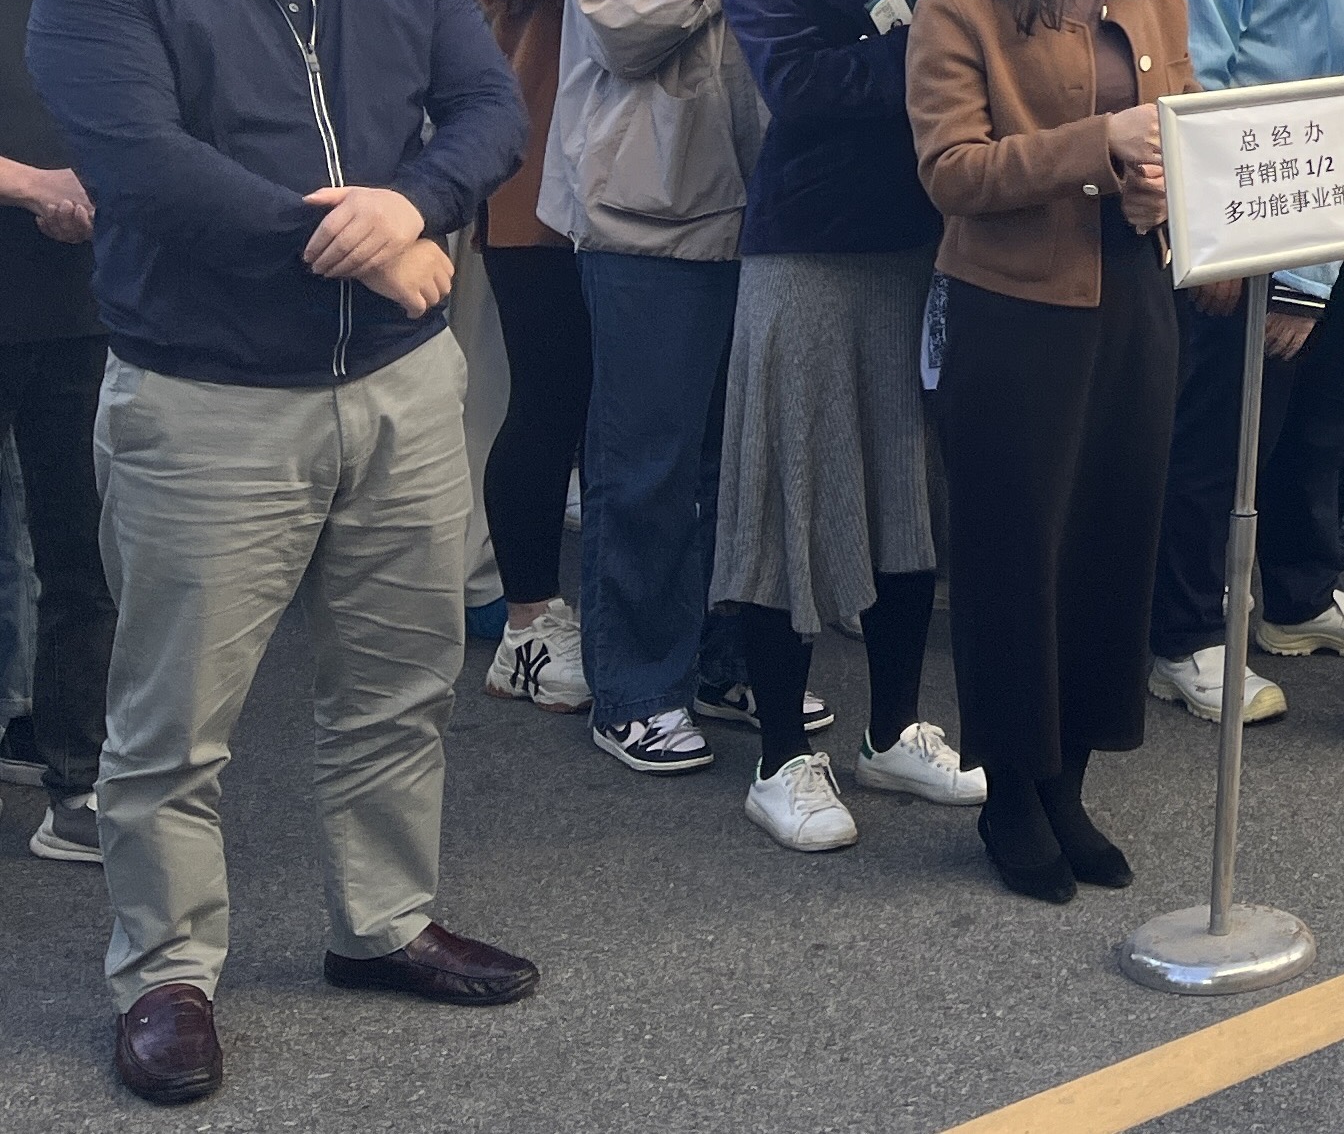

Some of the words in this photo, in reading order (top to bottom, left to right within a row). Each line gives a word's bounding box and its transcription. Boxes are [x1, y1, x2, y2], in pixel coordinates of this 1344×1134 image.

[1234, 157, 1300, 188] 营销部
[1305, 155, 1335, 178] 1/2
